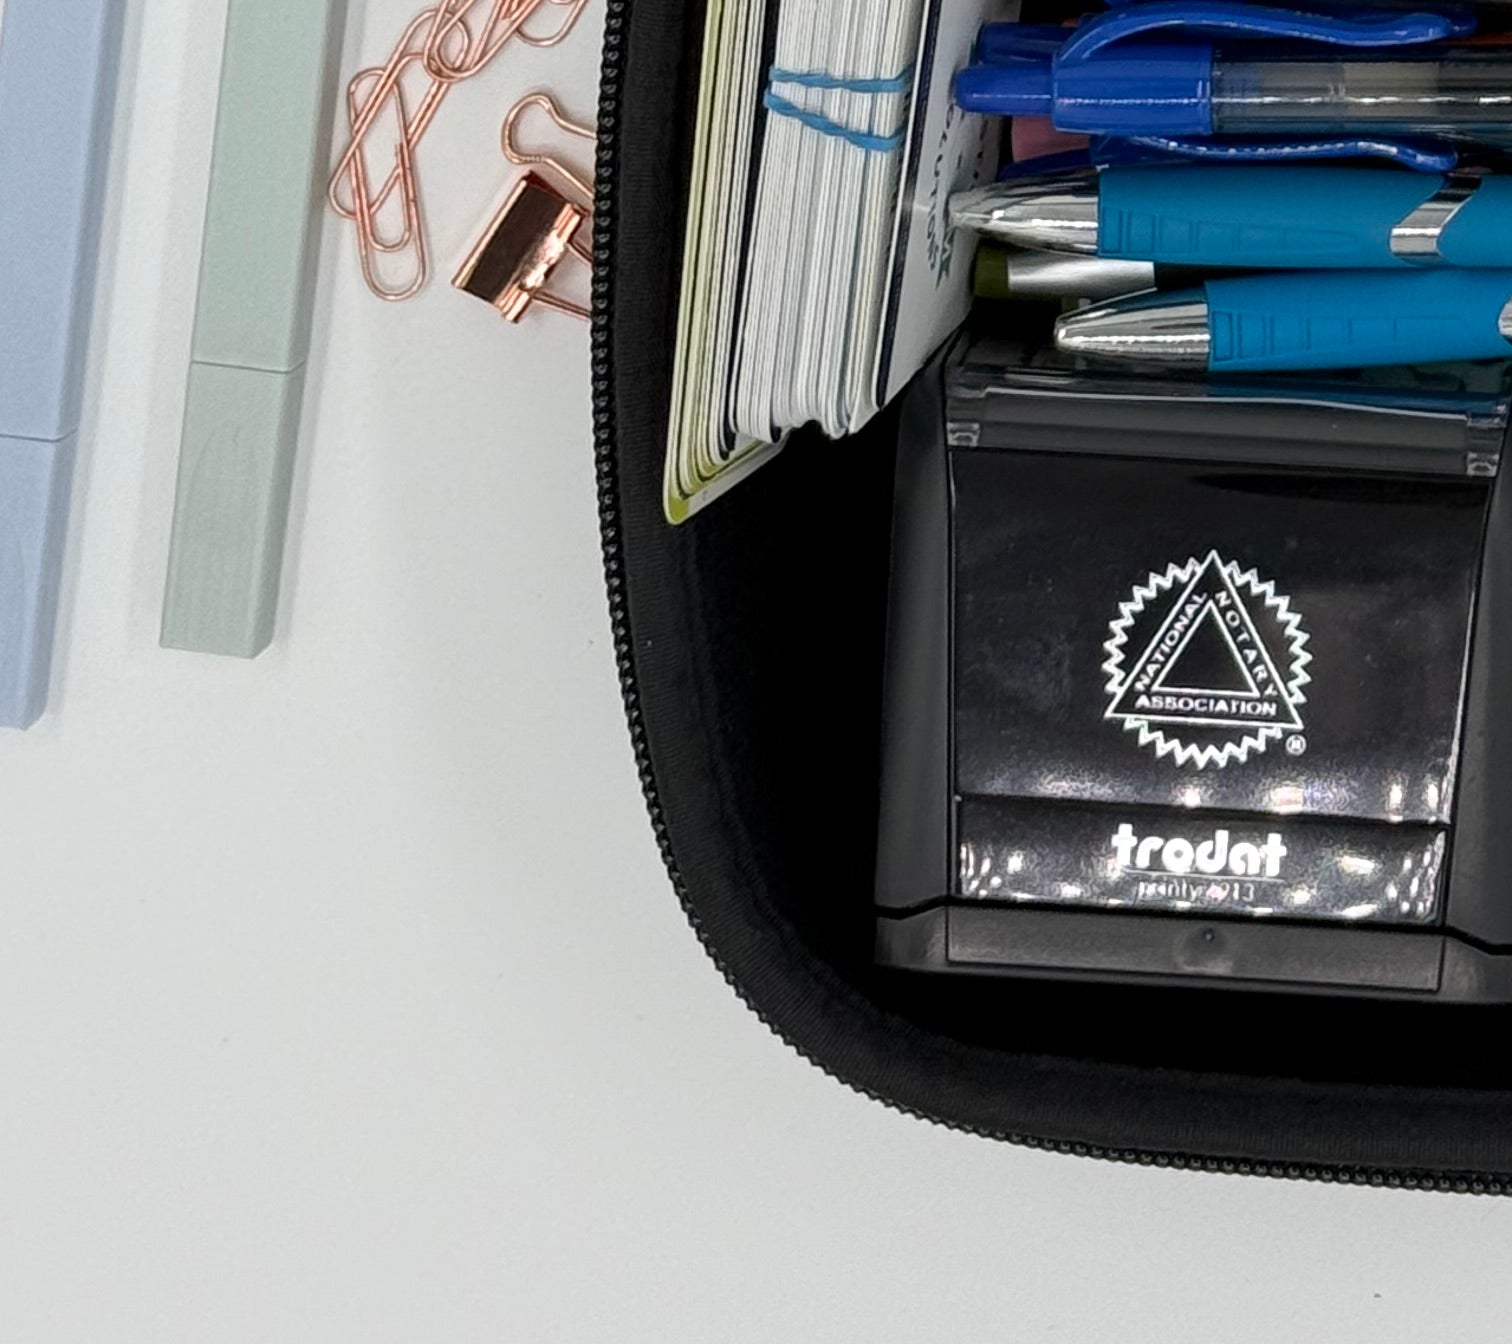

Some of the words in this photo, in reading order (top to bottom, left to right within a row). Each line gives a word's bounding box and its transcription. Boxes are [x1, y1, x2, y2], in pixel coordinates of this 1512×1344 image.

[1134, 592, 1208, 692] NATIONAL
[1215, 589, 1279, 698] NOTARY
[1134, 693, 1278, 717] ASSOCIATION
[1111, 823, 1287, 877] trodat
